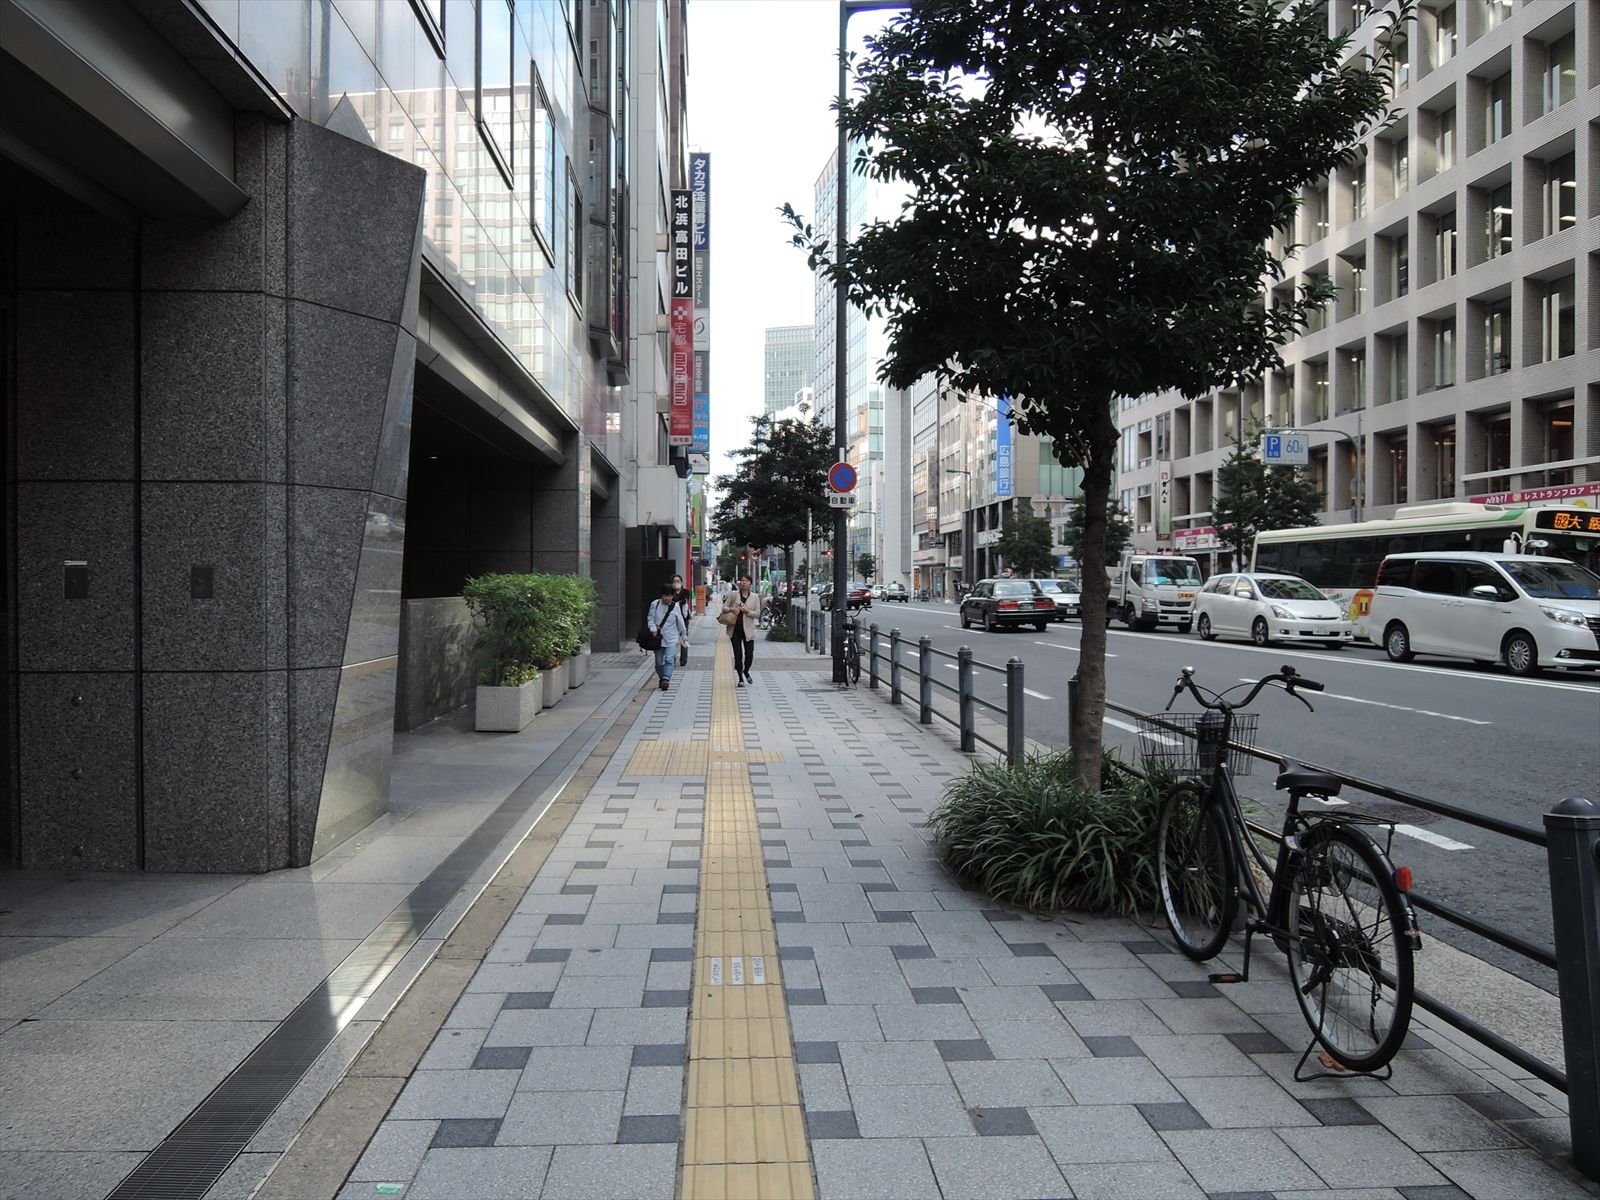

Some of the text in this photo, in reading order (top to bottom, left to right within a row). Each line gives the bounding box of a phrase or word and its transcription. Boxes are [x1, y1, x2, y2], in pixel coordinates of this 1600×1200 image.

[675, 195, 689, 295] 北浜高田ビル
[999, 445, 1010, 490] 広島銀行
[831, 496, 855, 505] 自動車
[1524, 487, 1585, 501] レストランフロア
